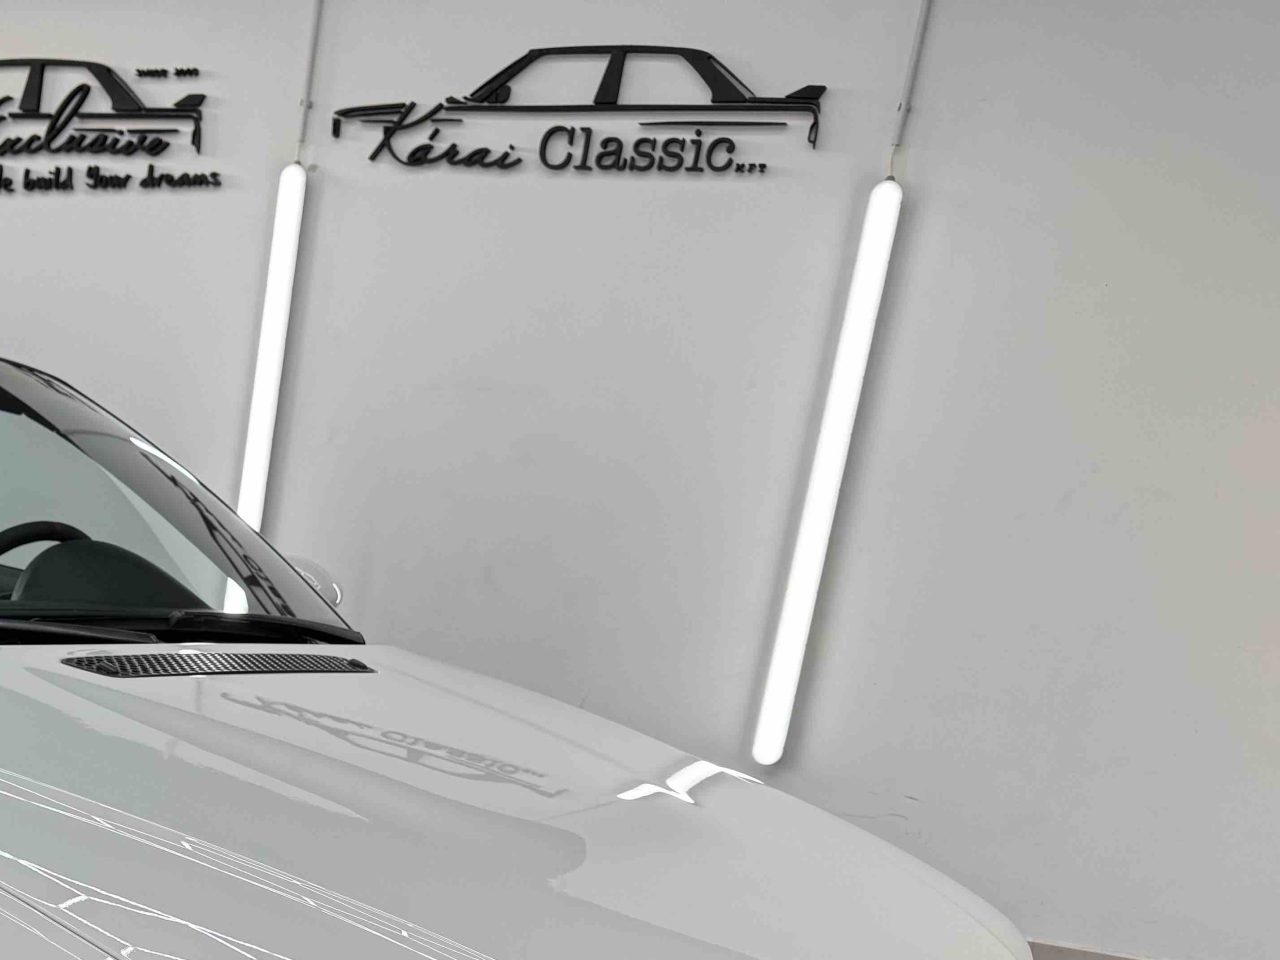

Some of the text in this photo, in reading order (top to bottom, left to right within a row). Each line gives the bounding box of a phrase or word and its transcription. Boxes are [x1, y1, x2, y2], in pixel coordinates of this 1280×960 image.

[369, 101, 523, 169] Kárai
[539, 125, 736, 172] Classic
[23, 167, 74, 192] build
[139, 163, 222, 188] dreams
